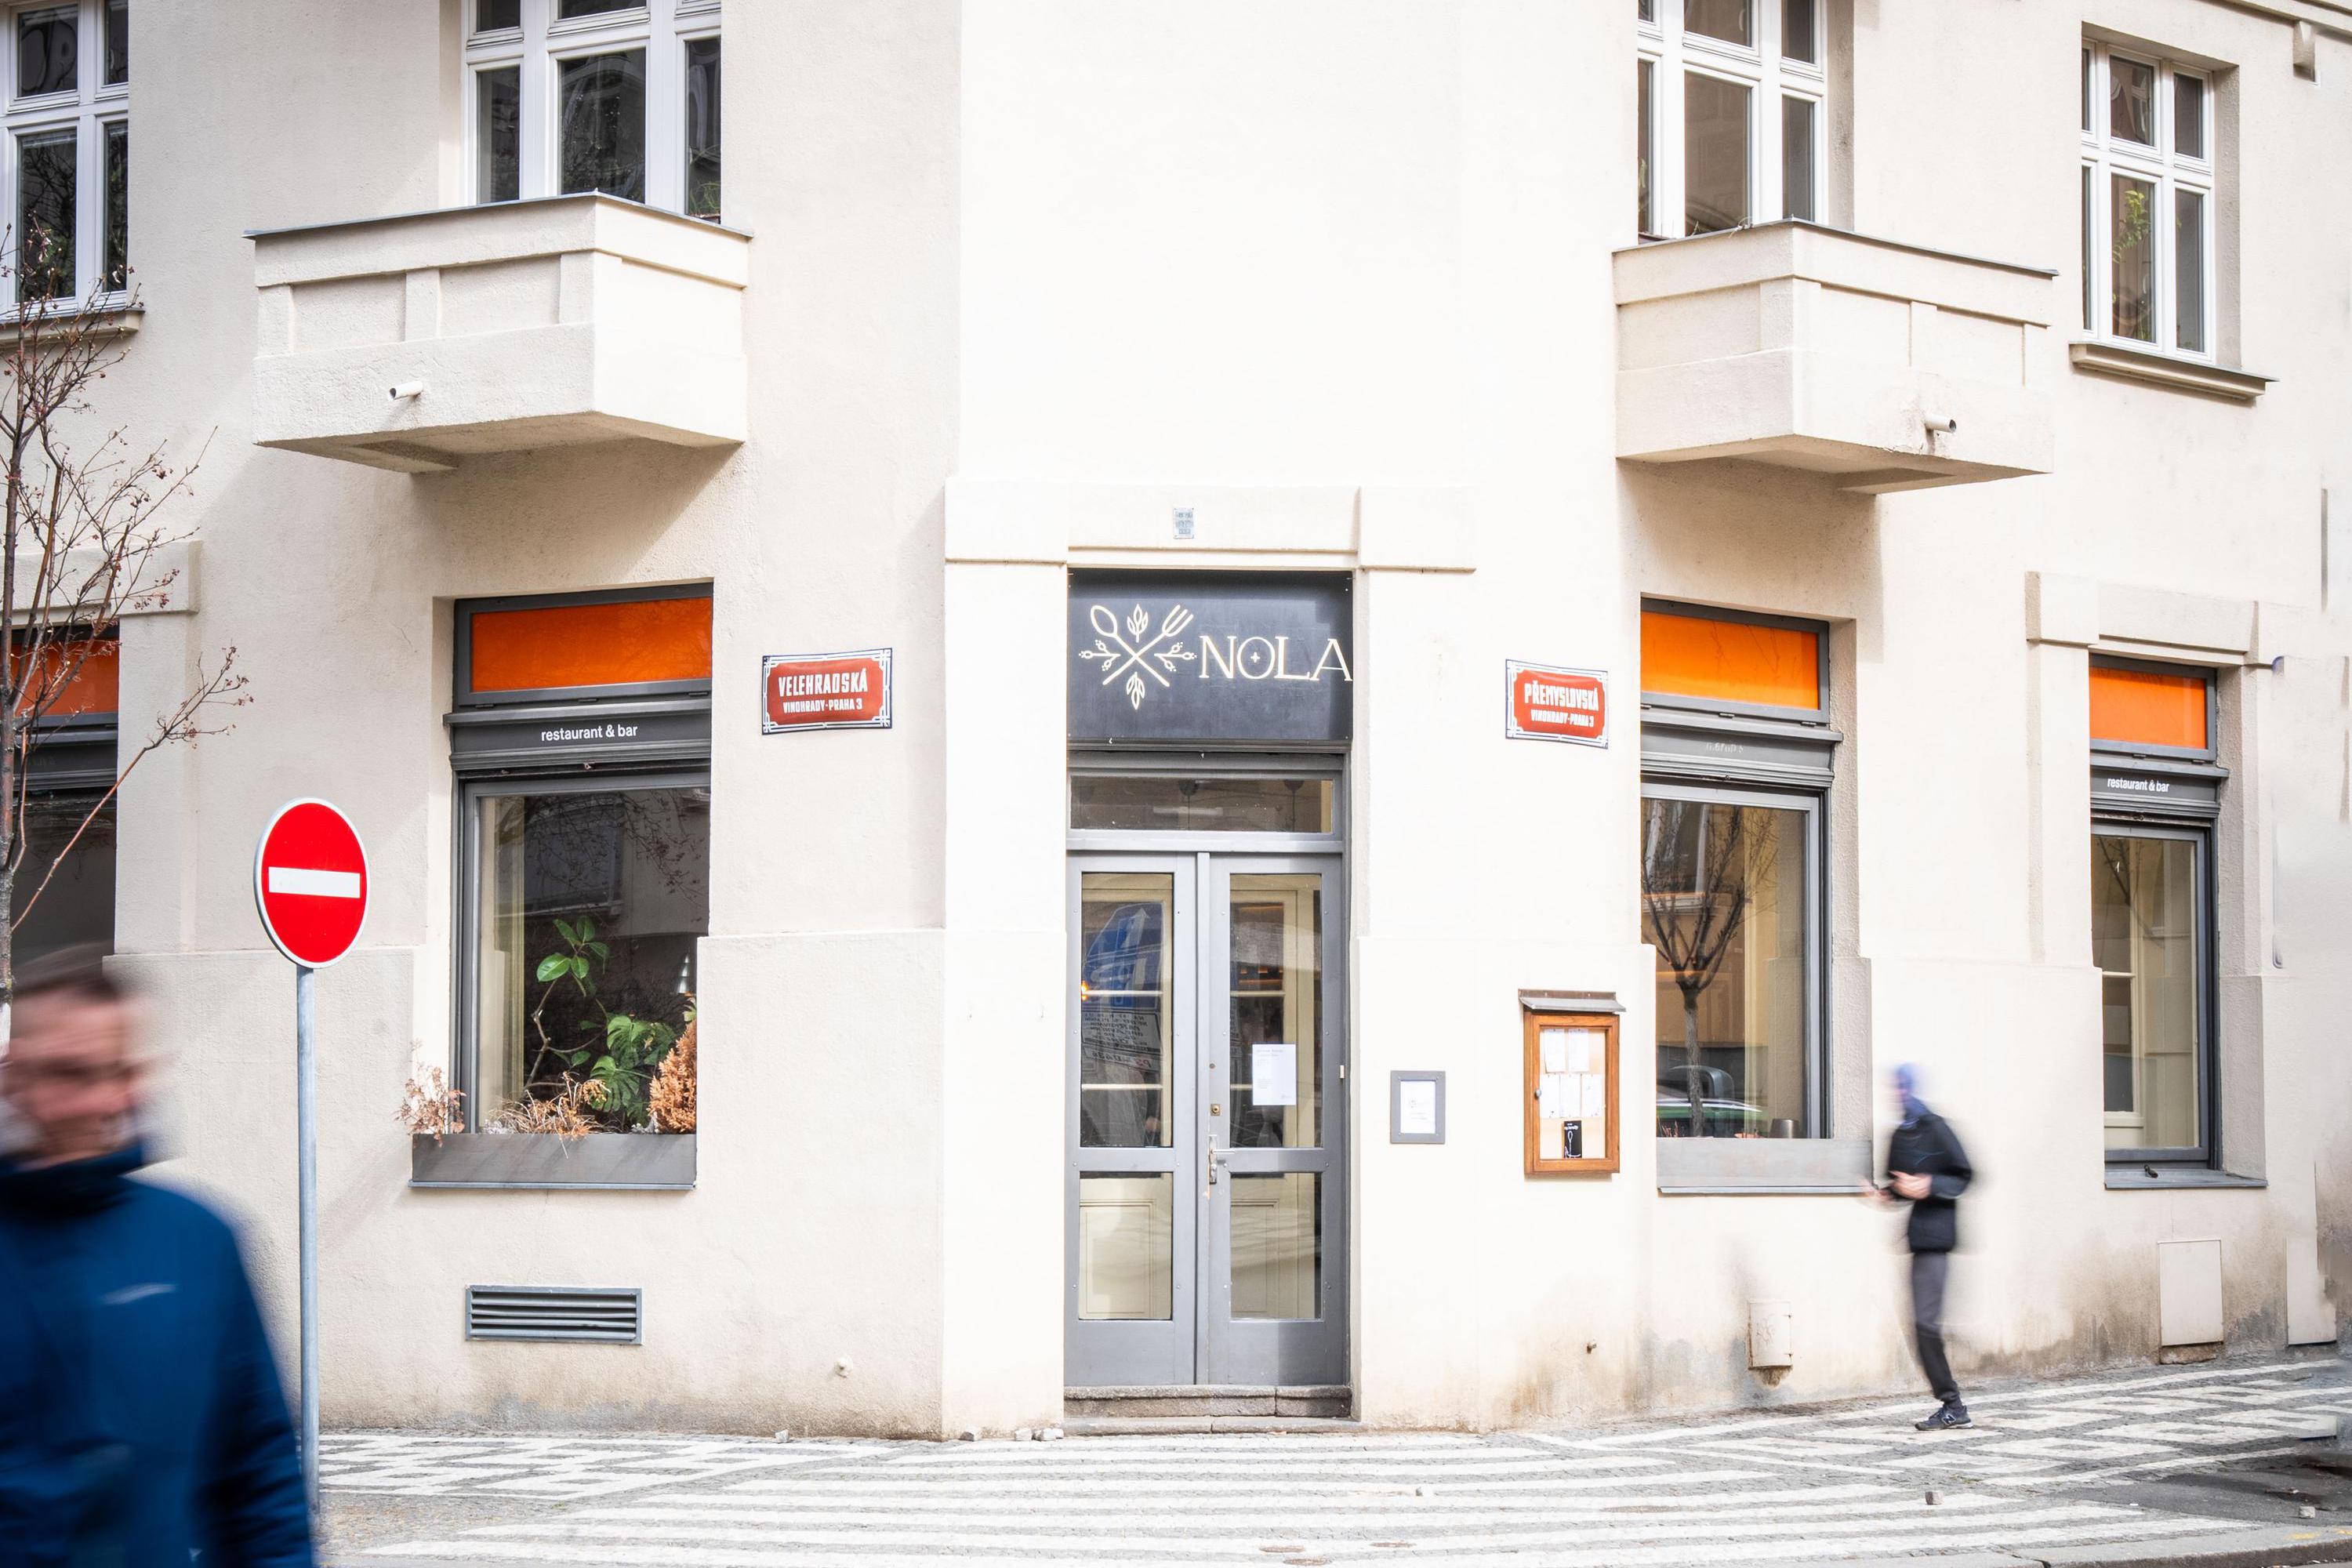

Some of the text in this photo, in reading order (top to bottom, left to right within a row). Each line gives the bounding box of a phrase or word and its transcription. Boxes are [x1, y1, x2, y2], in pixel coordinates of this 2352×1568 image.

[1199, 635, 1352, 681] NOLA
[778, 668, 868, 697] VELEHRADSKÁ
[856, 698, 862, 710] 3
[1524, 680, 1599, 711] PŘEMYSLOVSKÁ
[541, 724, 638, 742] restaurant & bar
[2107, 778, 2170, 793] restaurant & bar
[1941, 1414, 1956, 1426] N
